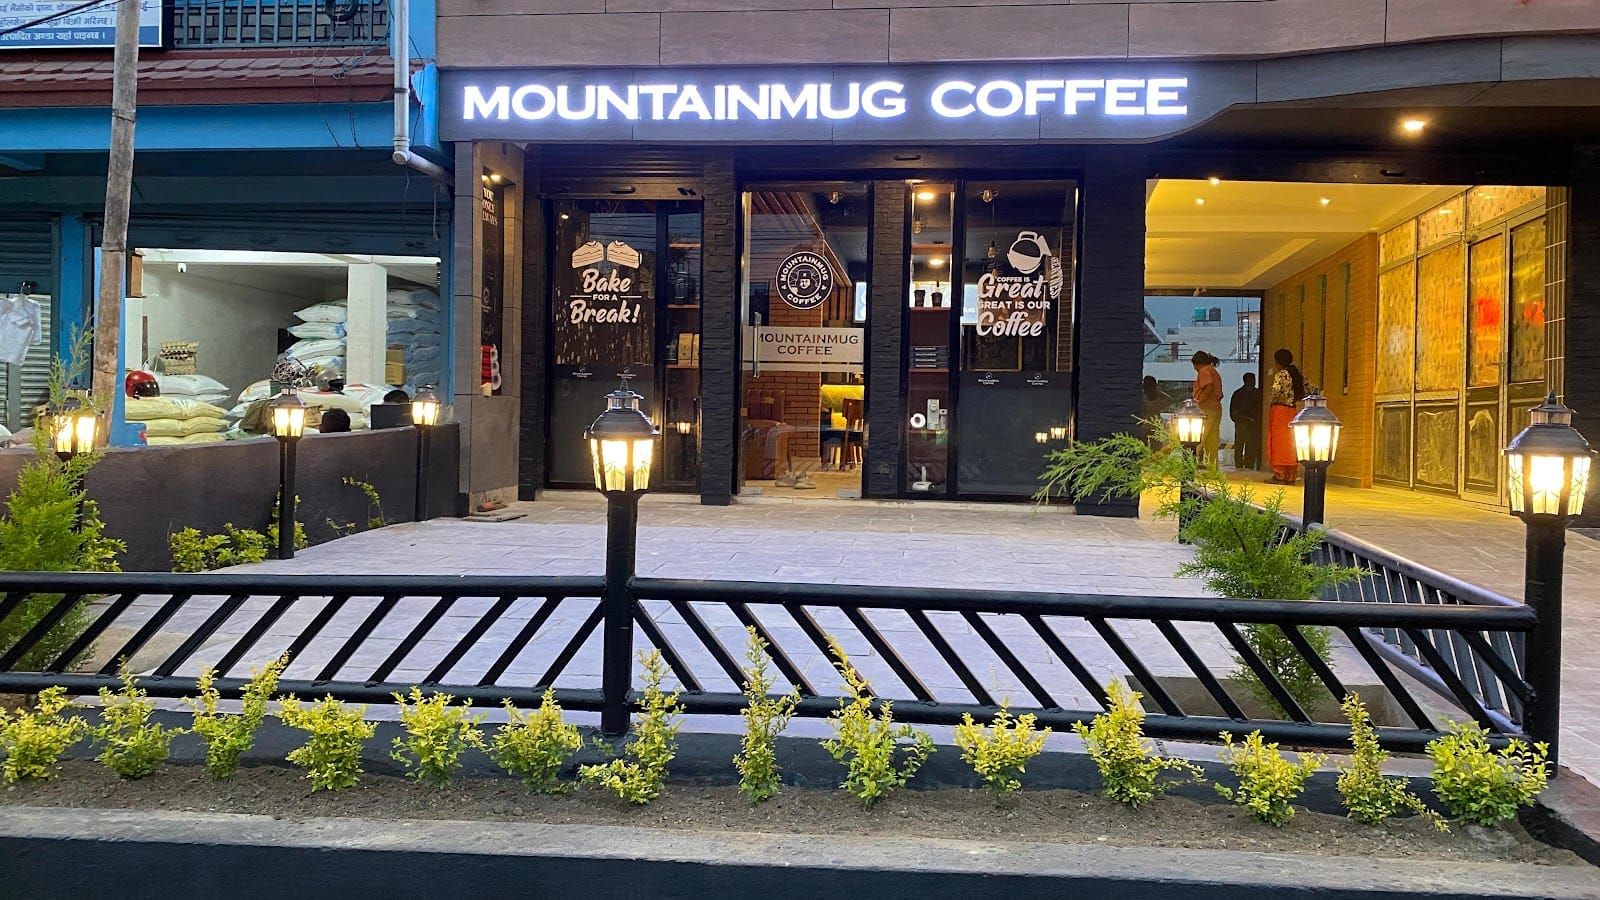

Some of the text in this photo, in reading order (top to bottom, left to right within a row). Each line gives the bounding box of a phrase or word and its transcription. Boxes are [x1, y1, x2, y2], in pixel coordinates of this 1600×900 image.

[463, 77, 1188, 120] MOUNTAINMUG COFFEE
[582, 268, 631, 293] Bake
[780, 255, 829, 282] MOUNTAINMUG
[977, 273, 1048, 299] Great
[569, 299, 641, 324] Break!
[786, 293, 822, 305] COFFEE
[978, 301, 1051, 310] GREAT IS OUR
[976, 311, 1043, 337] Coffee
[777, 345, 832, 356] COFFEE
